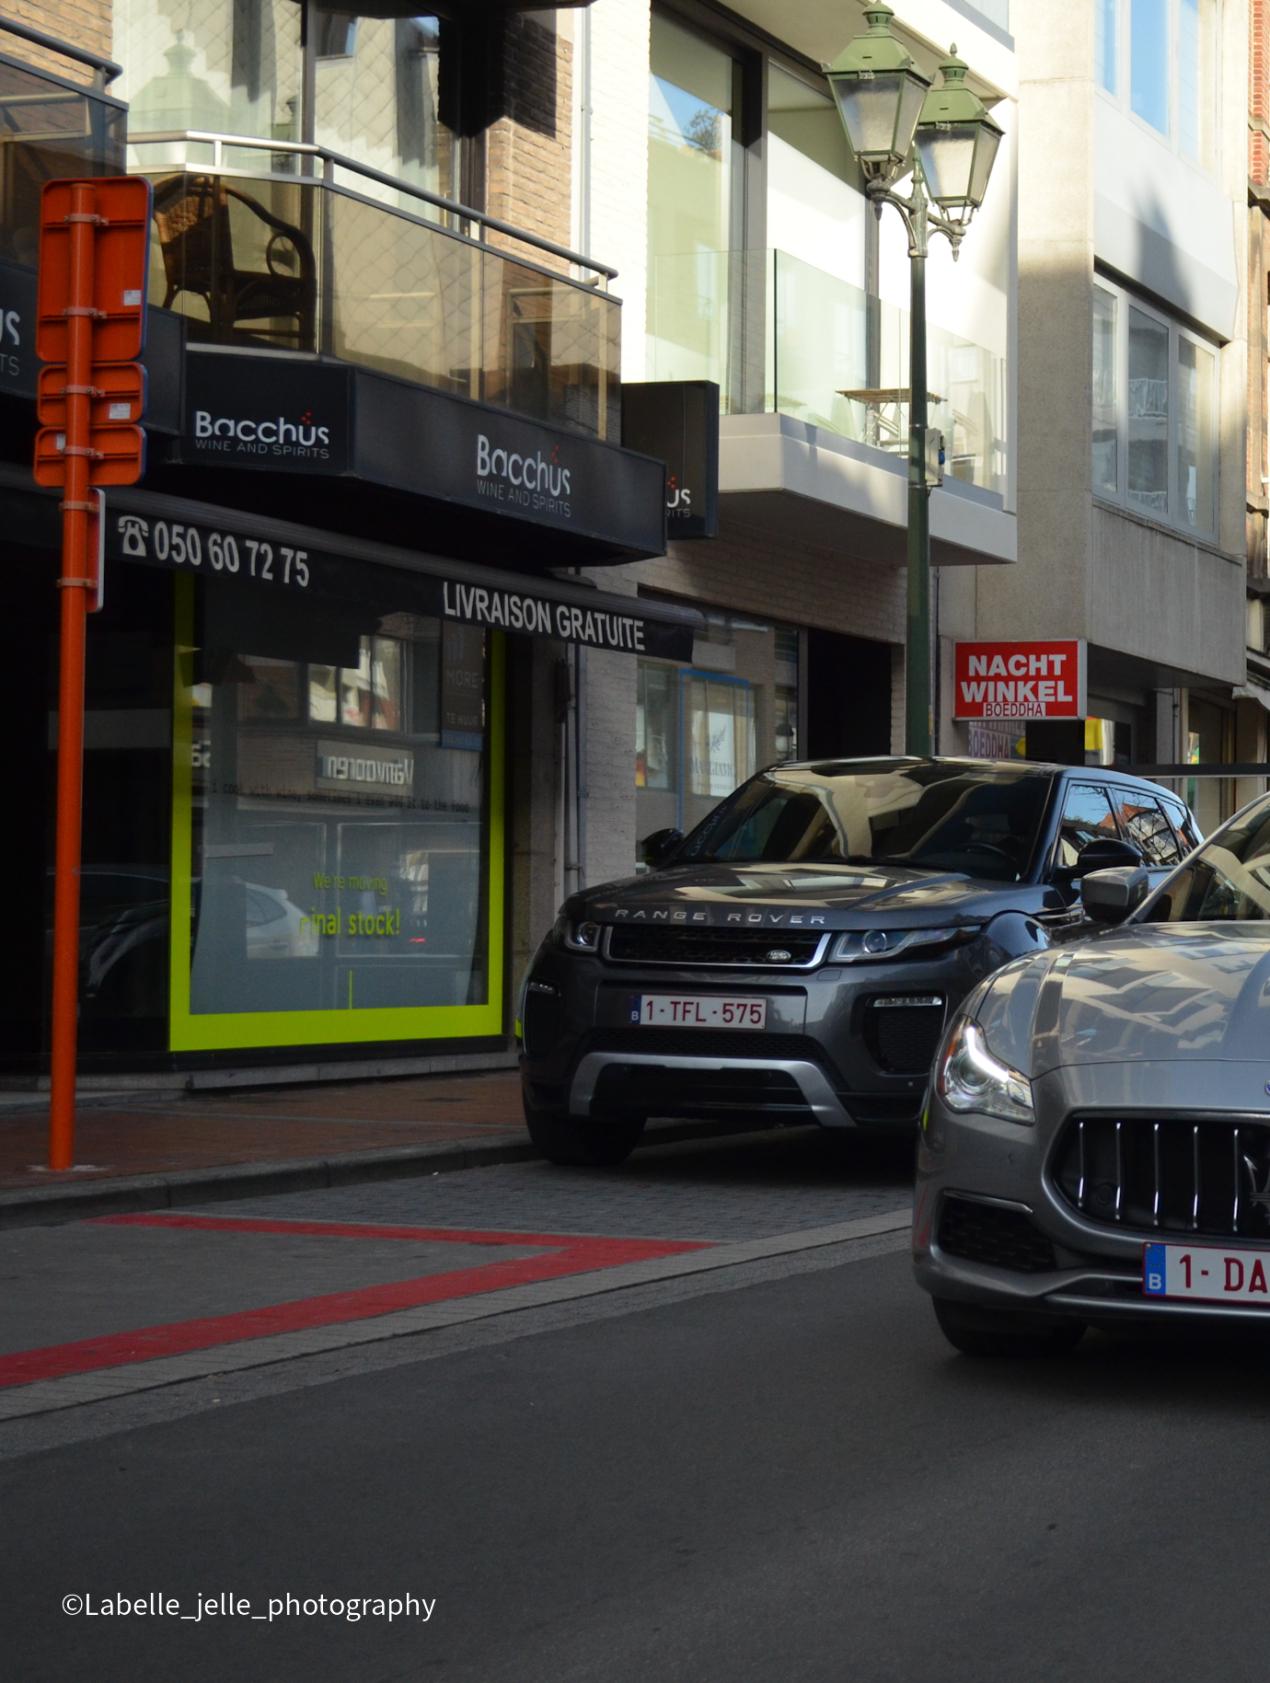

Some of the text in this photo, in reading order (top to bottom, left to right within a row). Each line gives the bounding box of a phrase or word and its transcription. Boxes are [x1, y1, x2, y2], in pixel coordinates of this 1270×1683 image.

[196, 410, 329, 446] Bacchus
[195, 439, 330, 460] WINE AND SPIRITS
[477, 434, 571, 497] Bacchus
[476, 479, 572, 518] WINE AND SPIRITS
[153, 521, 310, 588] 050 60 72 75
[443, 581, 646, 651] LIVRAISON GRATUITE
[968, 654, 1067, 677] NACHT
[960, 681, 1073, 703] WINKEL
[985, 702, 1044, 718] BOEDDHA
[348, 907, 401, 935] stock!
[614, 908, 826, 925] RANGE ROVER
[631, 1010, 639, 1021] B
[645, 999, 762, 1024] 1-TFL-575
[1148, 1273, 1162, 1290] B
